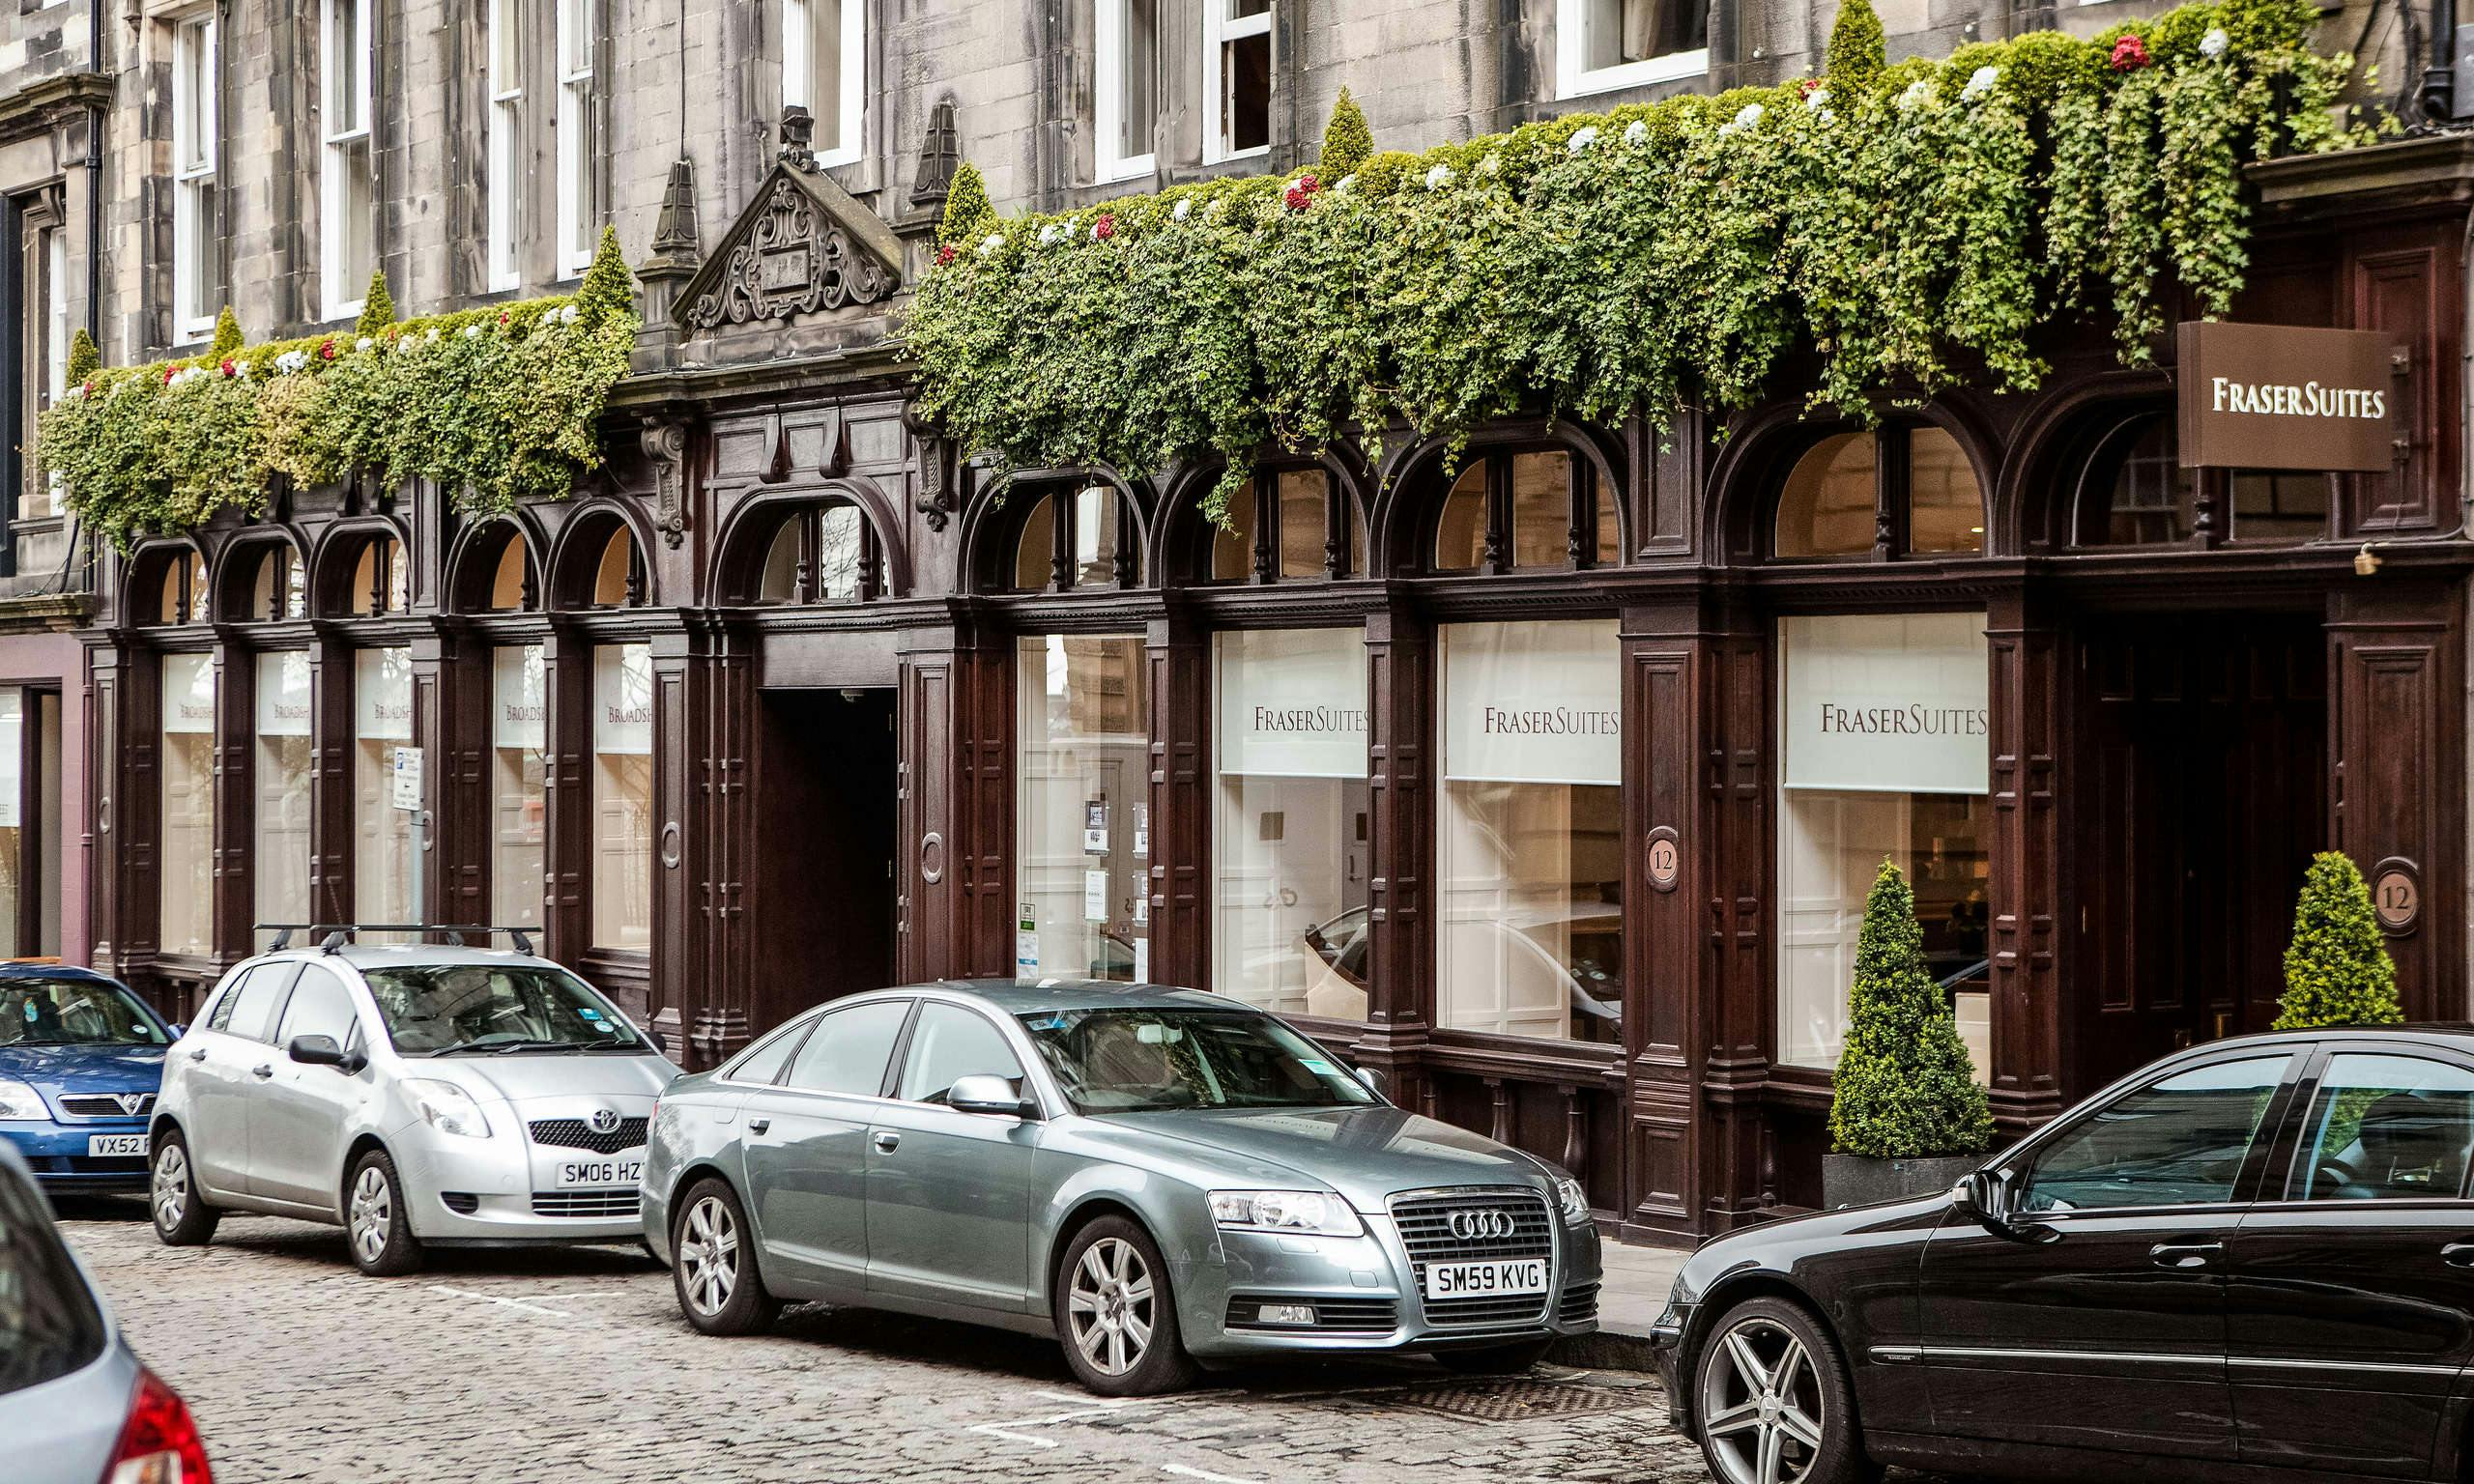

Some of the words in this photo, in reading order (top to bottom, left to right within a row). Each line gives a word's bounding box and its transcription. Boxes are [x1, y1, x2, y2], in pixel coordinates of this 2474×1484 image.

[1654, 850, 1673, 870] 12
[2384, 886, 2409, 909] 12
[97, 1138, 139, 1154] VX52
[565, 1163, 613, 1183] SM06
[1438, 1266, 1496, 1292] SM59
[1501, 1264, 1539, 1289] KVG
